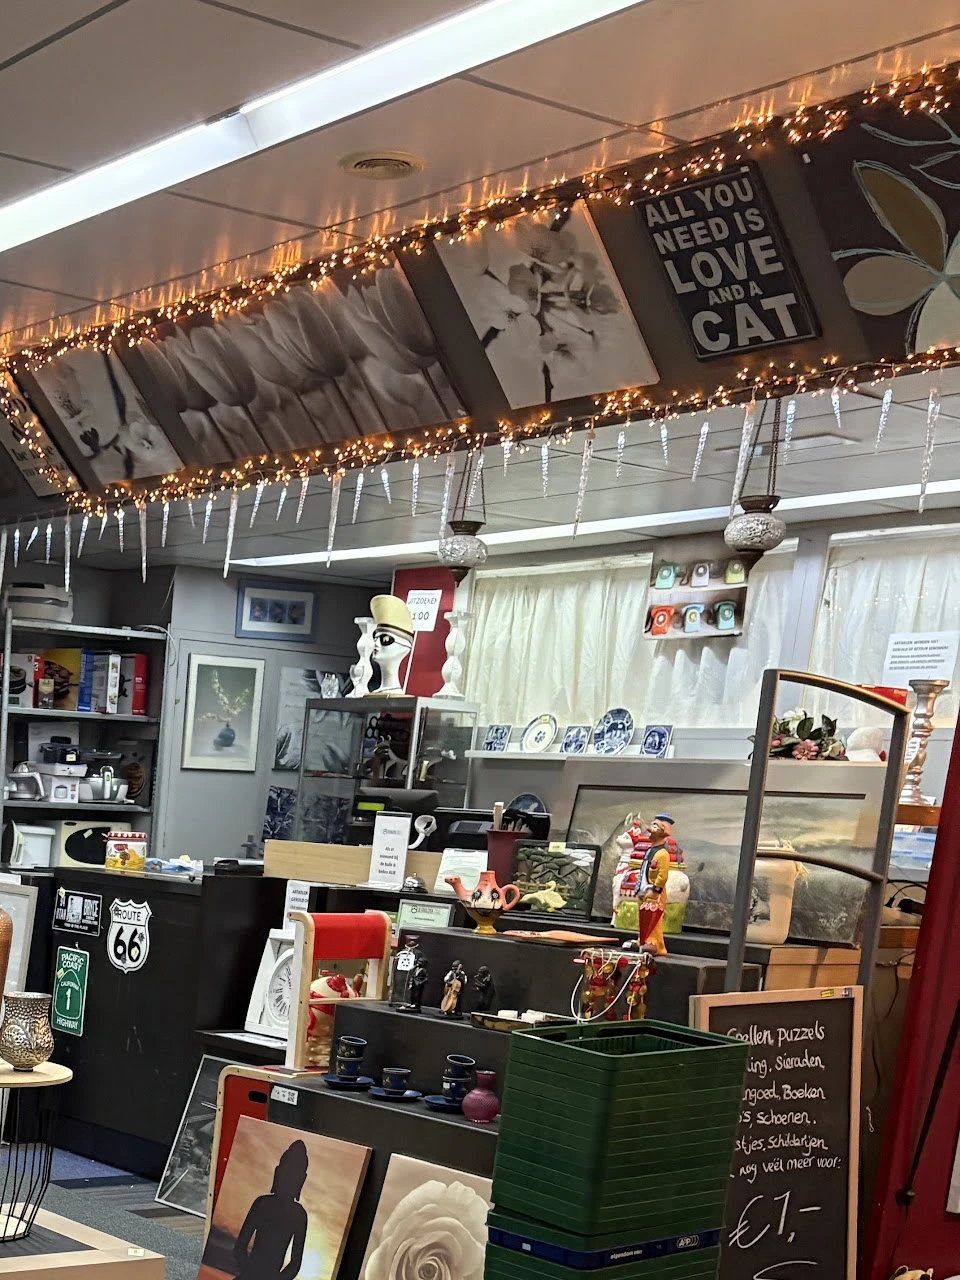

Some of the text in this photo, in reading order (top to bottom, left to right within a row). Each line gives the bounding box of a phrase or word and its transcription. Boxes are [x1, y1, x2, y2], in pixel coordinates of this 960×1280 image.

[645, 177, 754, 228] ALL YOU
[653, 207, 765, 254] NEED IS
[664, 235, 784, 294] LOVE
[708, 280, 763, 306] AND A
[691, 292, 798, 351] CAT
[118, 909, 142, 922] ROUTE
[113, 925, 142, 963] 66
[61, 953, 85, 965] PACIFIC
[62, 960, 82, 972] COAST
[65, 988, 71, 1010] 1
[56, 1016, 79, 1030] HIGHWAY
[782, 1082, 826, 1100] Boeken
[739, 1163, 757, 1184] nog
[786, 1156, 815, 1170] meer
